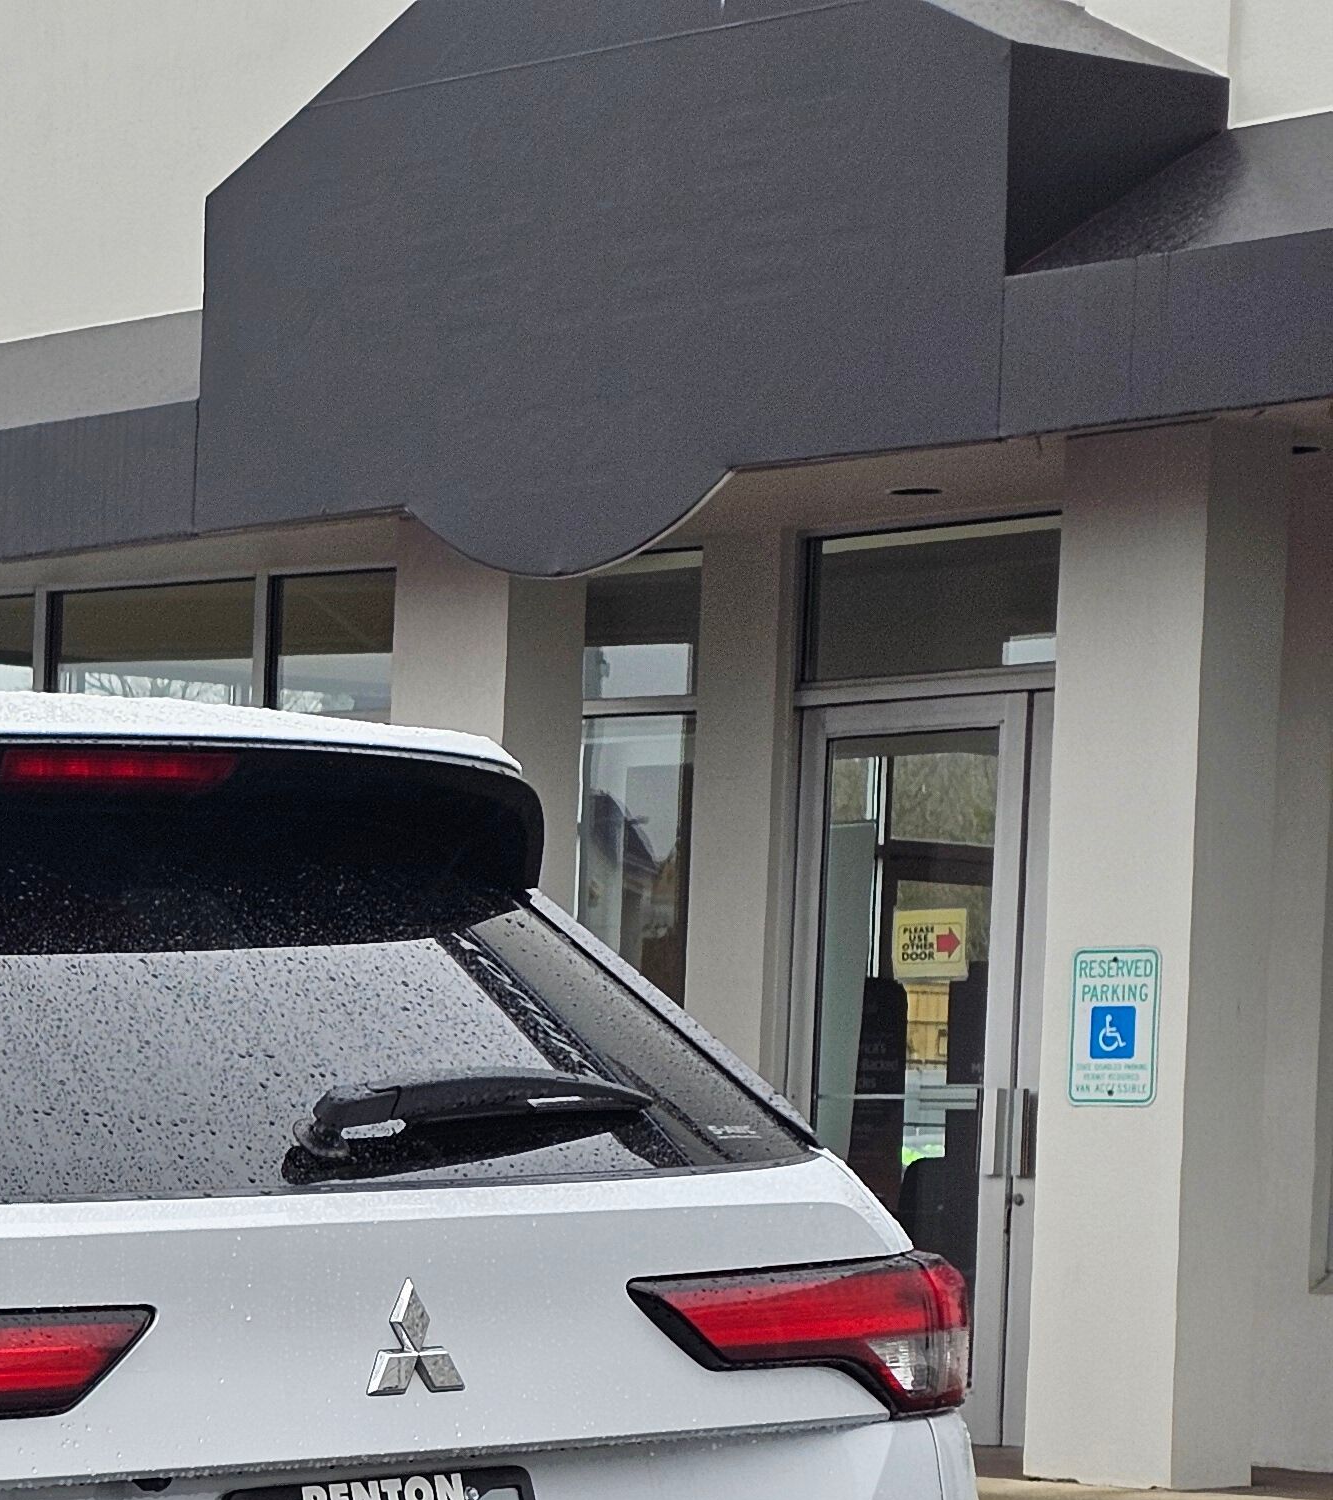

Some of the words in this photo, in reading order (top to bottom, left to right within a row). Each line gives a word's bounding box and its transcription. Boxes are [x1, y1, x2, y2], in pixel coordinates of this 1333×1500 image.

[902, 925, 935, 934] PLEASE
[908, 934, 928, 942] USE
[901, 942, 935, 952] OTHER
[901, 951, 935, 961] DOOR
[1079, 959, 1153, 978] RESERVED
[1081, 983, 1149, 1002] PARKING
[1076, 1083, 1091, 1093] VAN
[1094, 1083, 1147, 1094] ACCESSIBLE
